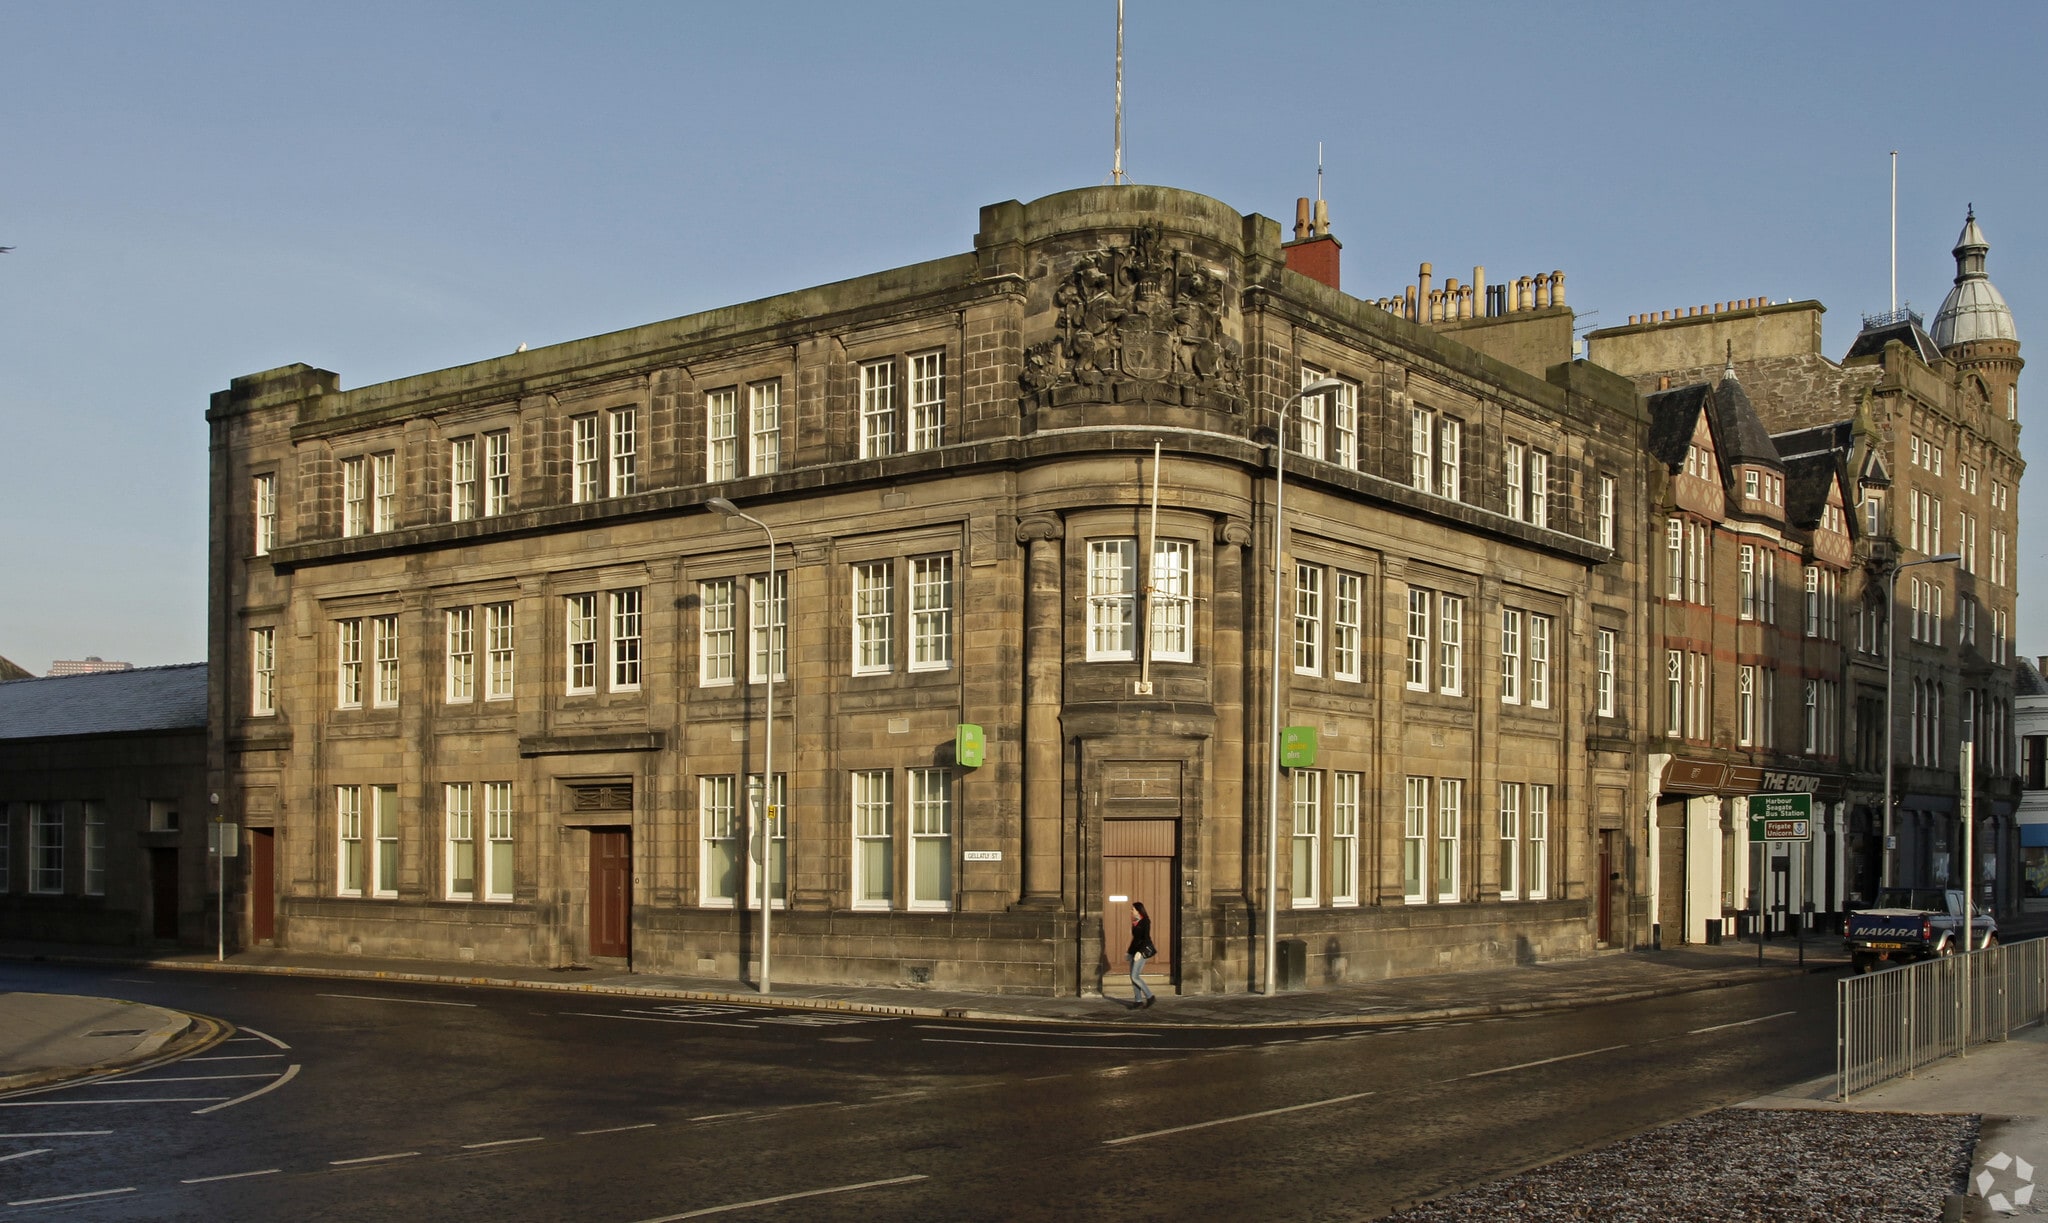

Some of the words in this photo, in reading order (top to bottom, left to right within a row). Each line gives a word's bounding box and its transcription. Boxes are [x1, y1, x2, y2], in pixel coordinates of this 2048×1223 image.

[1763, 772, 1787, 789] THE
[1786, 775, 1820, 793] BOND
[1855, 927, 1918, 937] NAVARA
